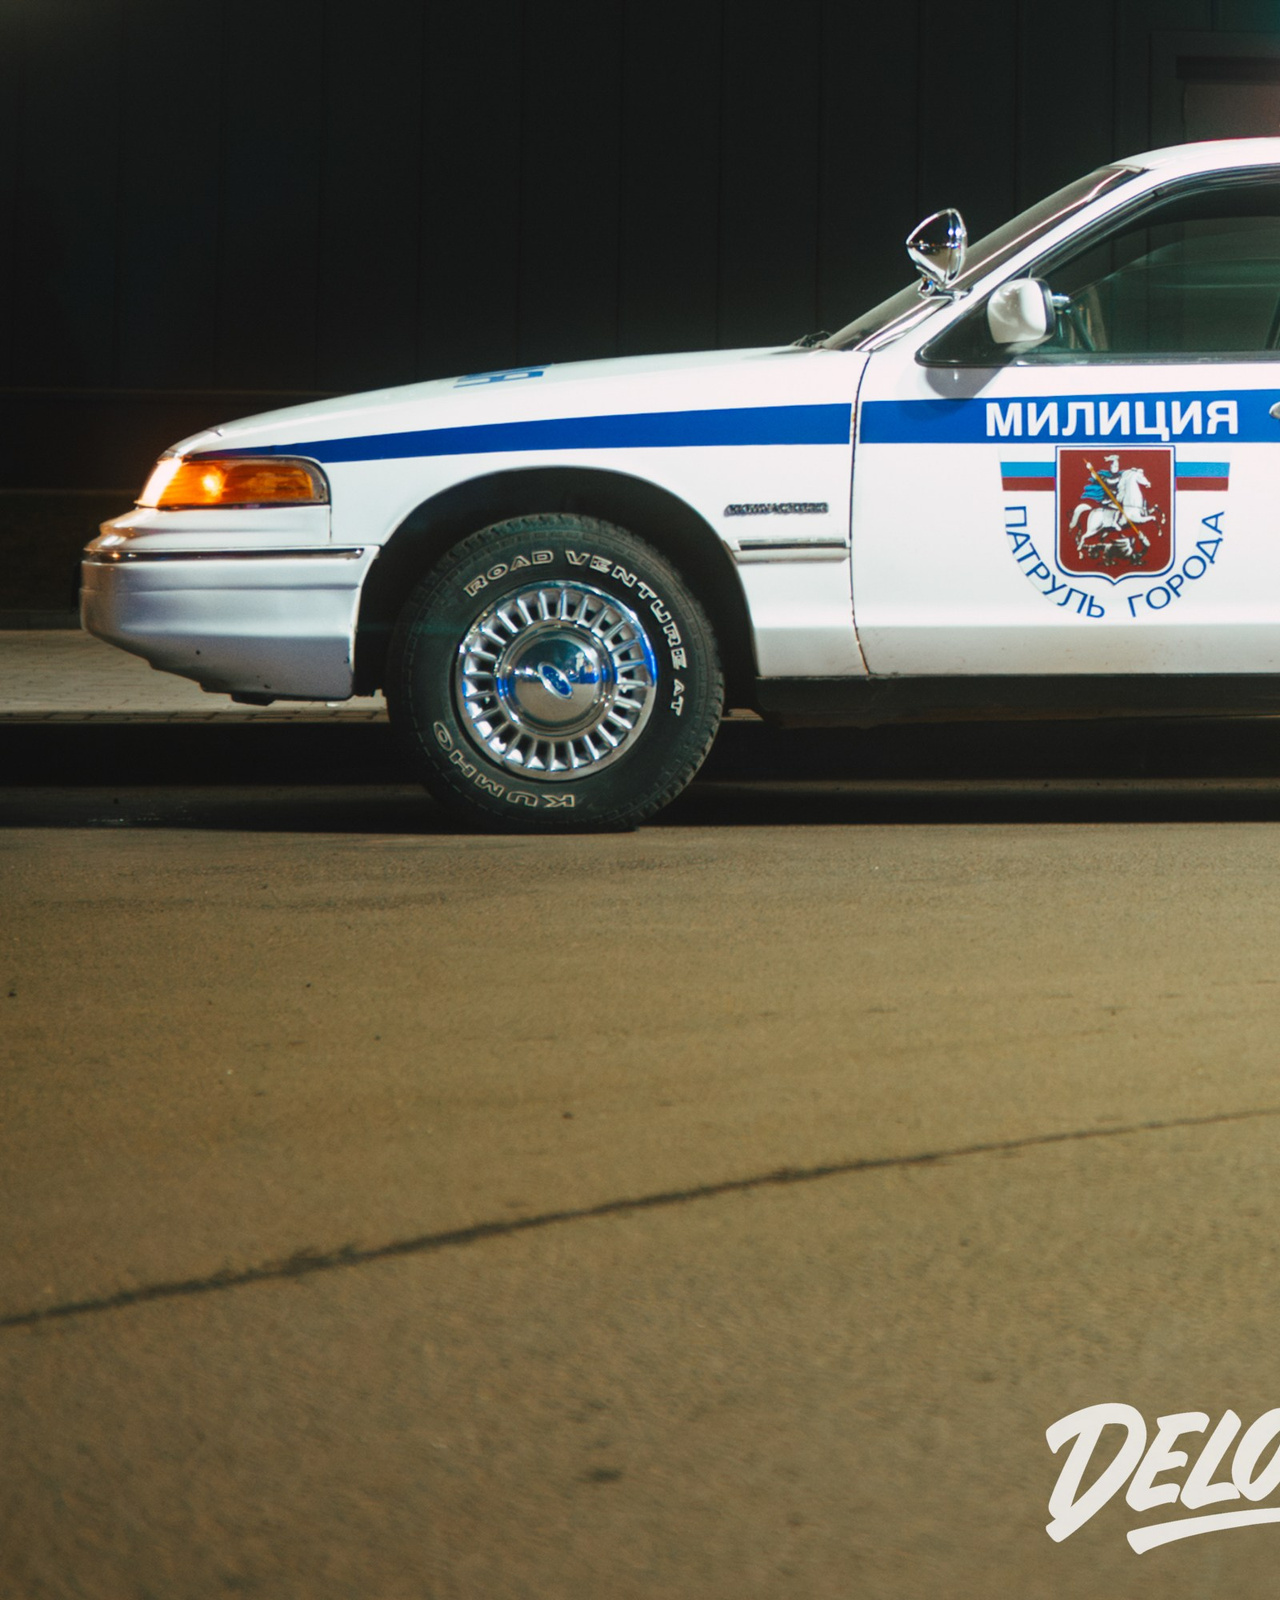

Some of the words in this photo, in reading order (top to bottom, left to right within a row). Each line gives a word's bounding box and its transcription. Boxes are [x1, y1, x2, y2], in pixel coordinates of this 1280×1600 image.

[986, 400, 1238, 441] МИЛИЦИЯ
[1004, 506, 1105, 618] ПАТРУЛЬ
[1127, 511, 1225, 617] ГОРОДА
[463, 550, 554, 598] ROAD
[565, 550, 688, 671] VENTURE
[671, 678, 686, 716] AT
[433, 721, 575, 808] KUMHO
